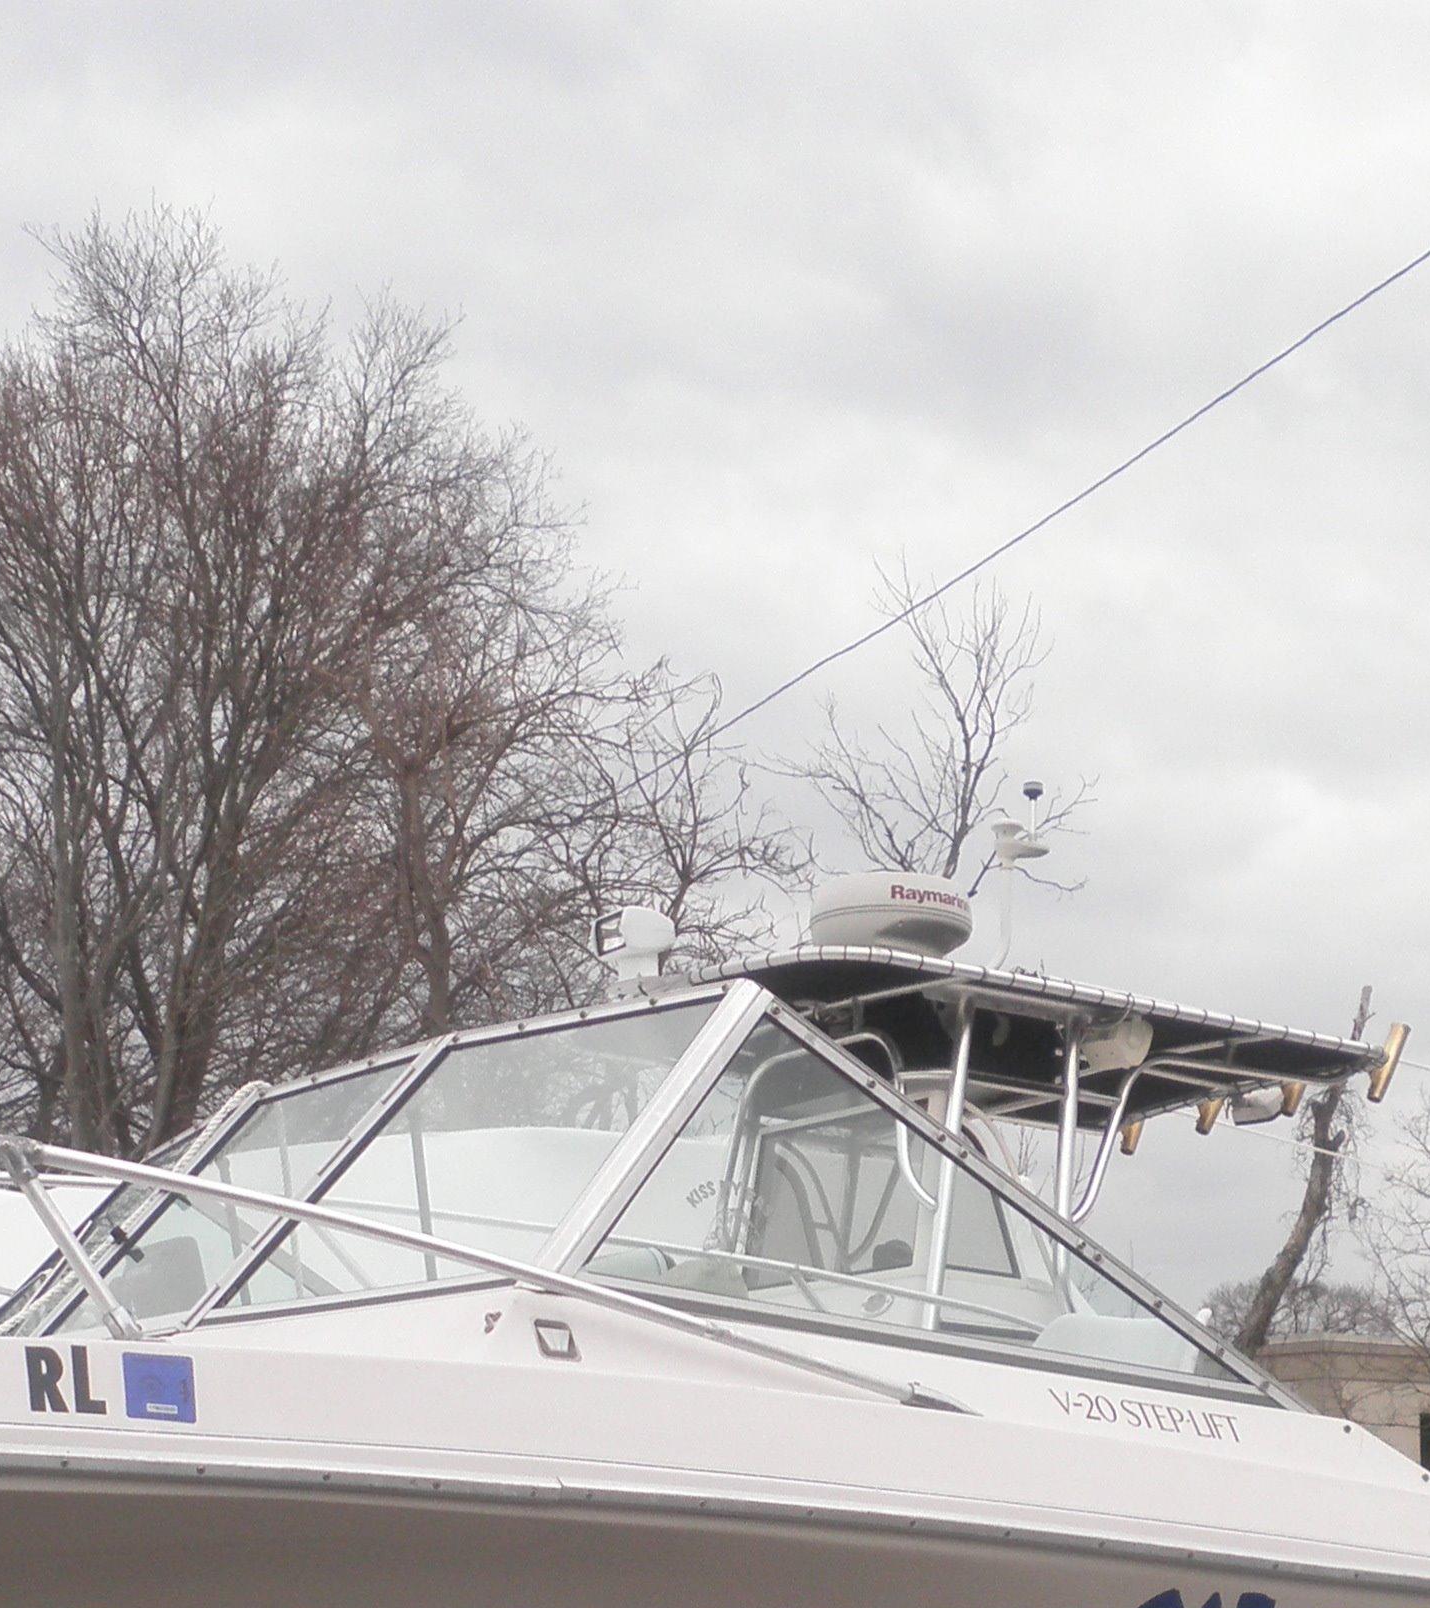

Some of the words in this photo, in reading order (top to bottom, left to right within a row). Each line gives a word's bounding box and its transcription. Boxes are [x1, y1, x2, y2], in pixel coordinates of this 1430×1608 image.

[891, 884, 970, 911] Raymarin
[686, 1180, 717, 1209] KISS
[26, 1345, 108, 1415] RL
[1048, 1388, 1118, 1424] V-20
